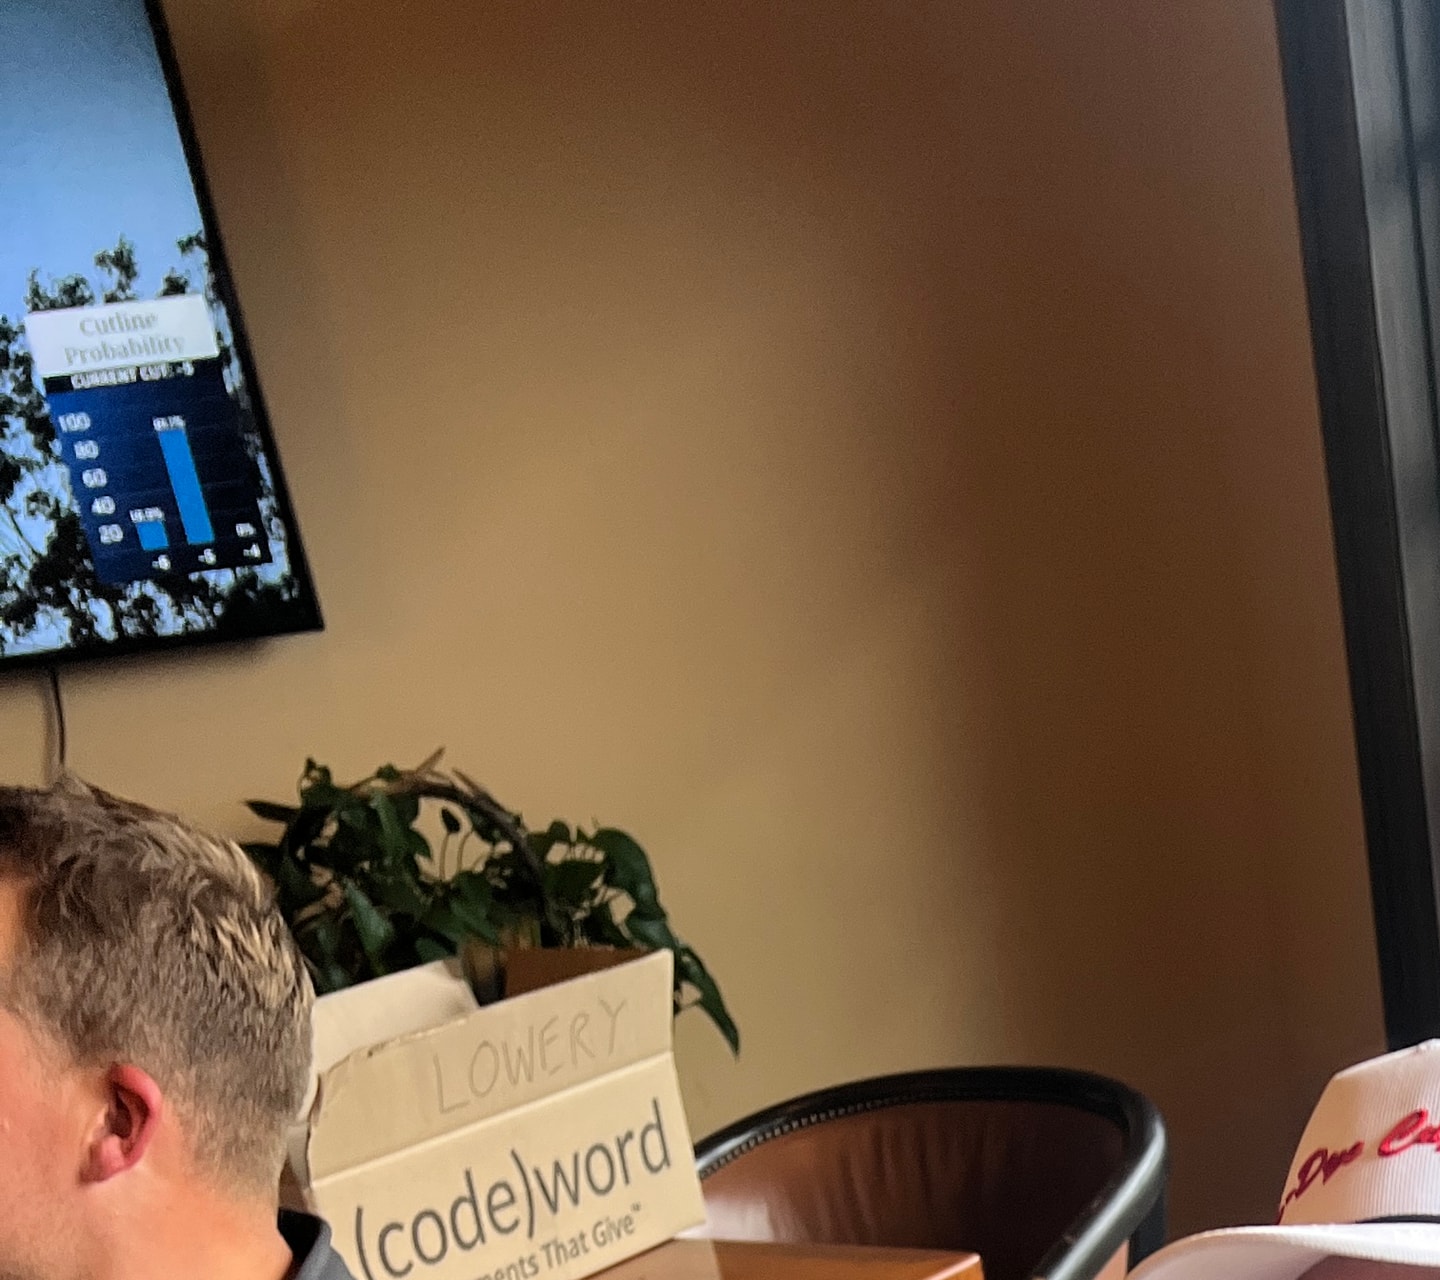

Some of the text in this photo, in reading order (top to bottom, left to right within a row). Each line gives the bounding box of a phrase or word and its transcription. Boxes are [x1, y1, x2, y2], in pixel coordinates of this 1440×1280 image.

[80, 311, 159, 337] Cutline
[65, 335, 184, 366] Probability
[58, 412, 91, 432] 100
[99, 524, 123, 544] 20
[432, 996, 627, 1114] LOWERY
[540, 1235, 591, 1269] That
